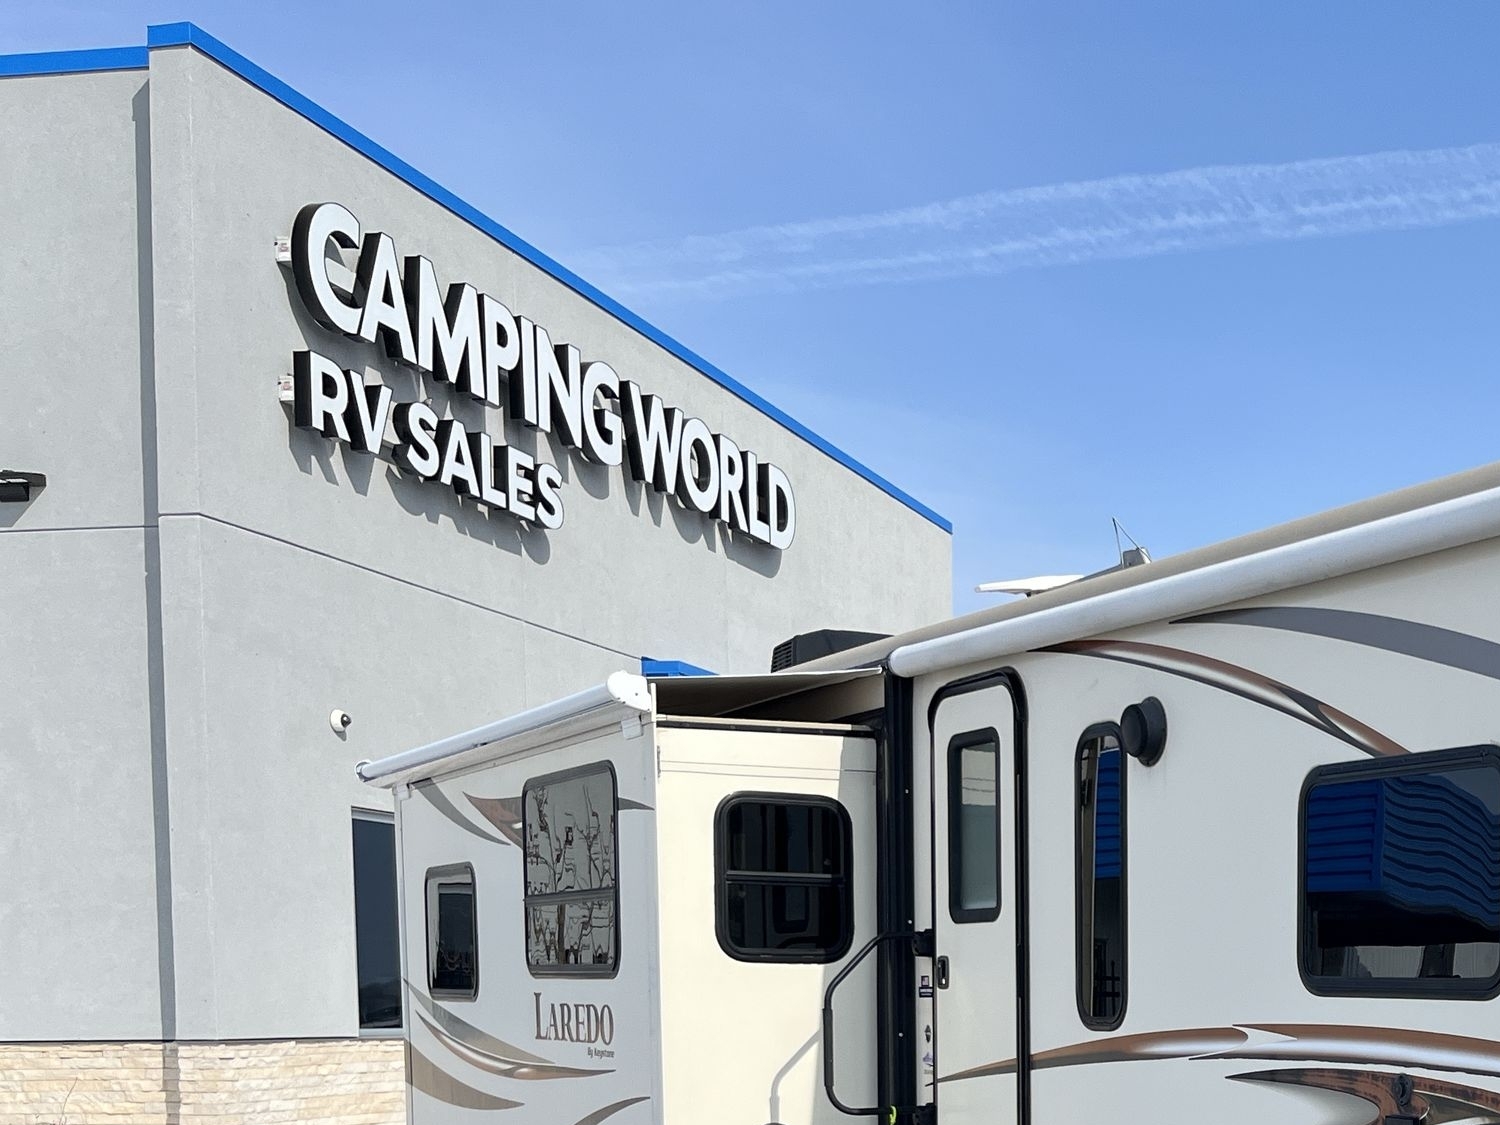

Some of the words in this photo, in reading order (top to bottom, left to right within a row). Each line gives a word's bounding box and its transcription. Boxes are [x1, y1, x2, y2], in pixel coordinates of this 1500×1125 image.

[291, 201, 623, 467] CAMPING
[619, 380, 797, 551] WORLD
[293, 349, 393, 456] RV
[393, 401, 565, 531] SALES
[533, 991, 614, 1046] LAREDO
